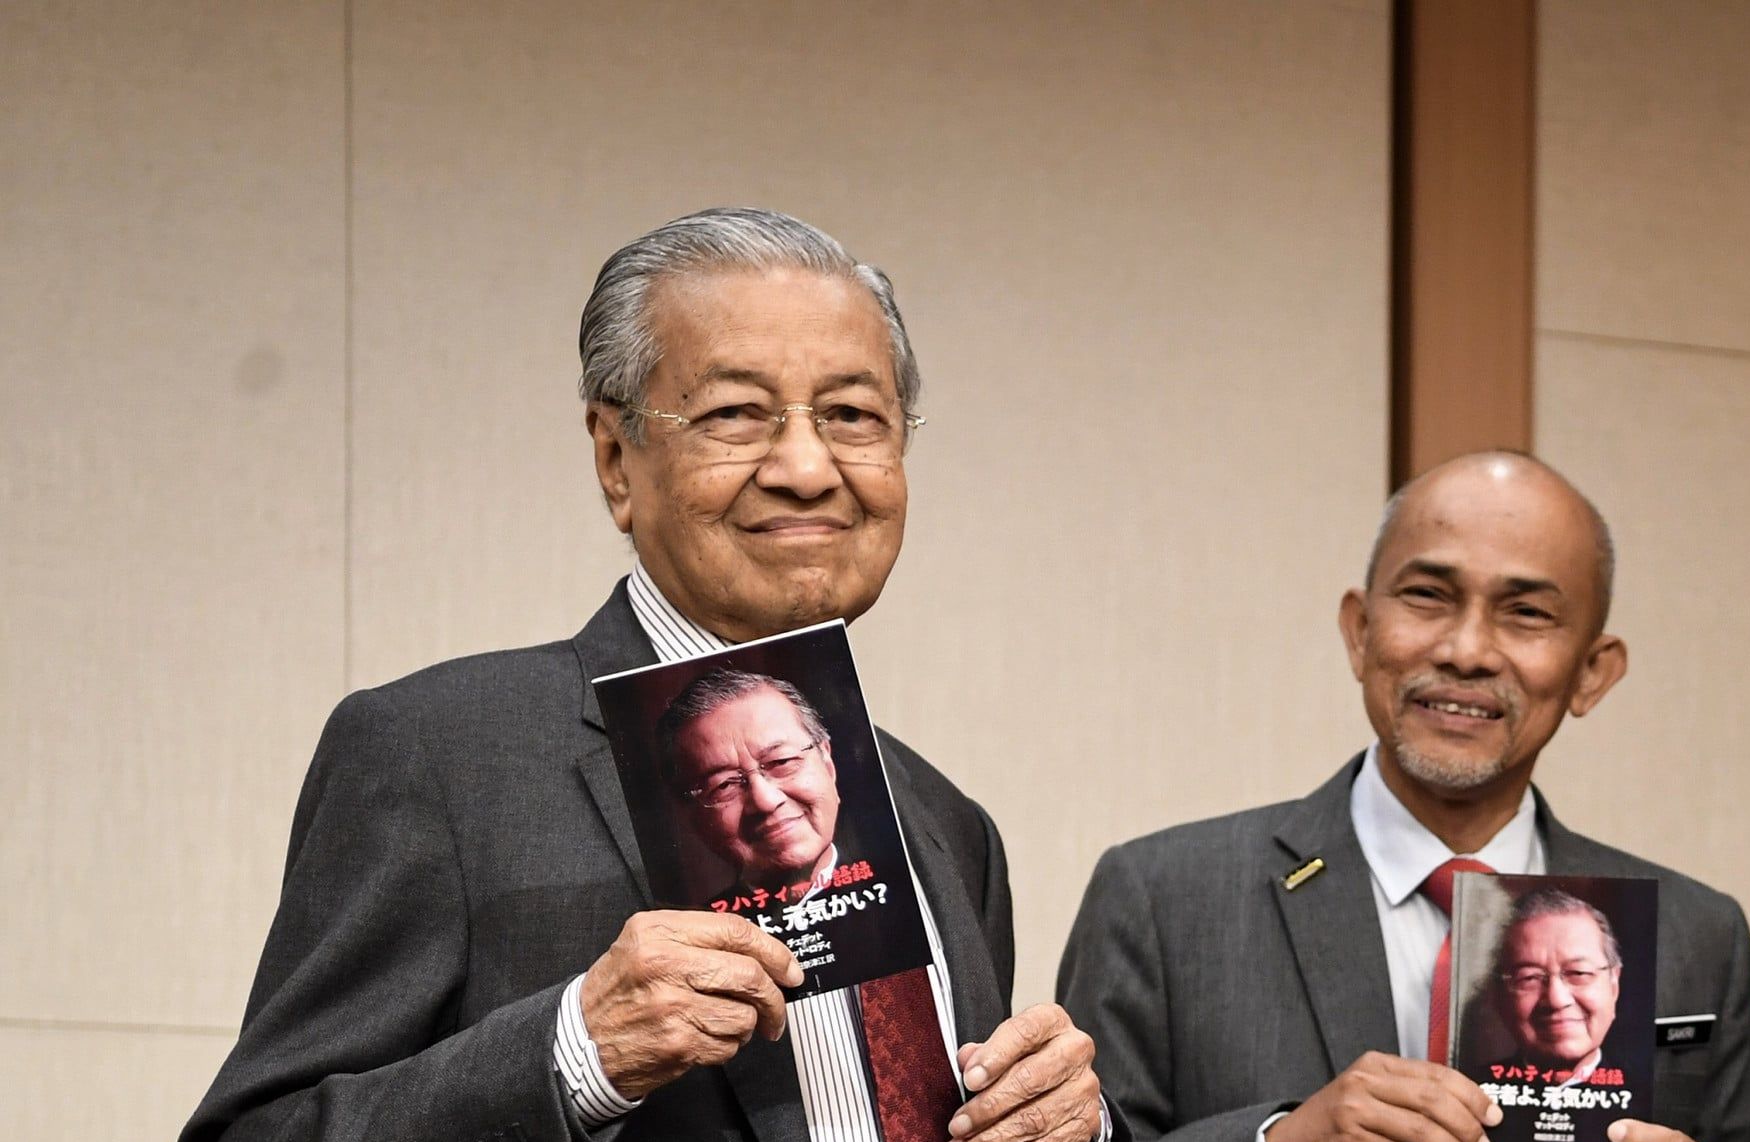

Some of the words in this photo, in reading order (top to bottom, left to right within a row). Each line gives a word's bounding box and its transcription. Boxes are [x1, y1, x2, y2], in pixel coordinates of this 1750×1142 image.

[757, 883, 888, 935] よ、元気かい？
